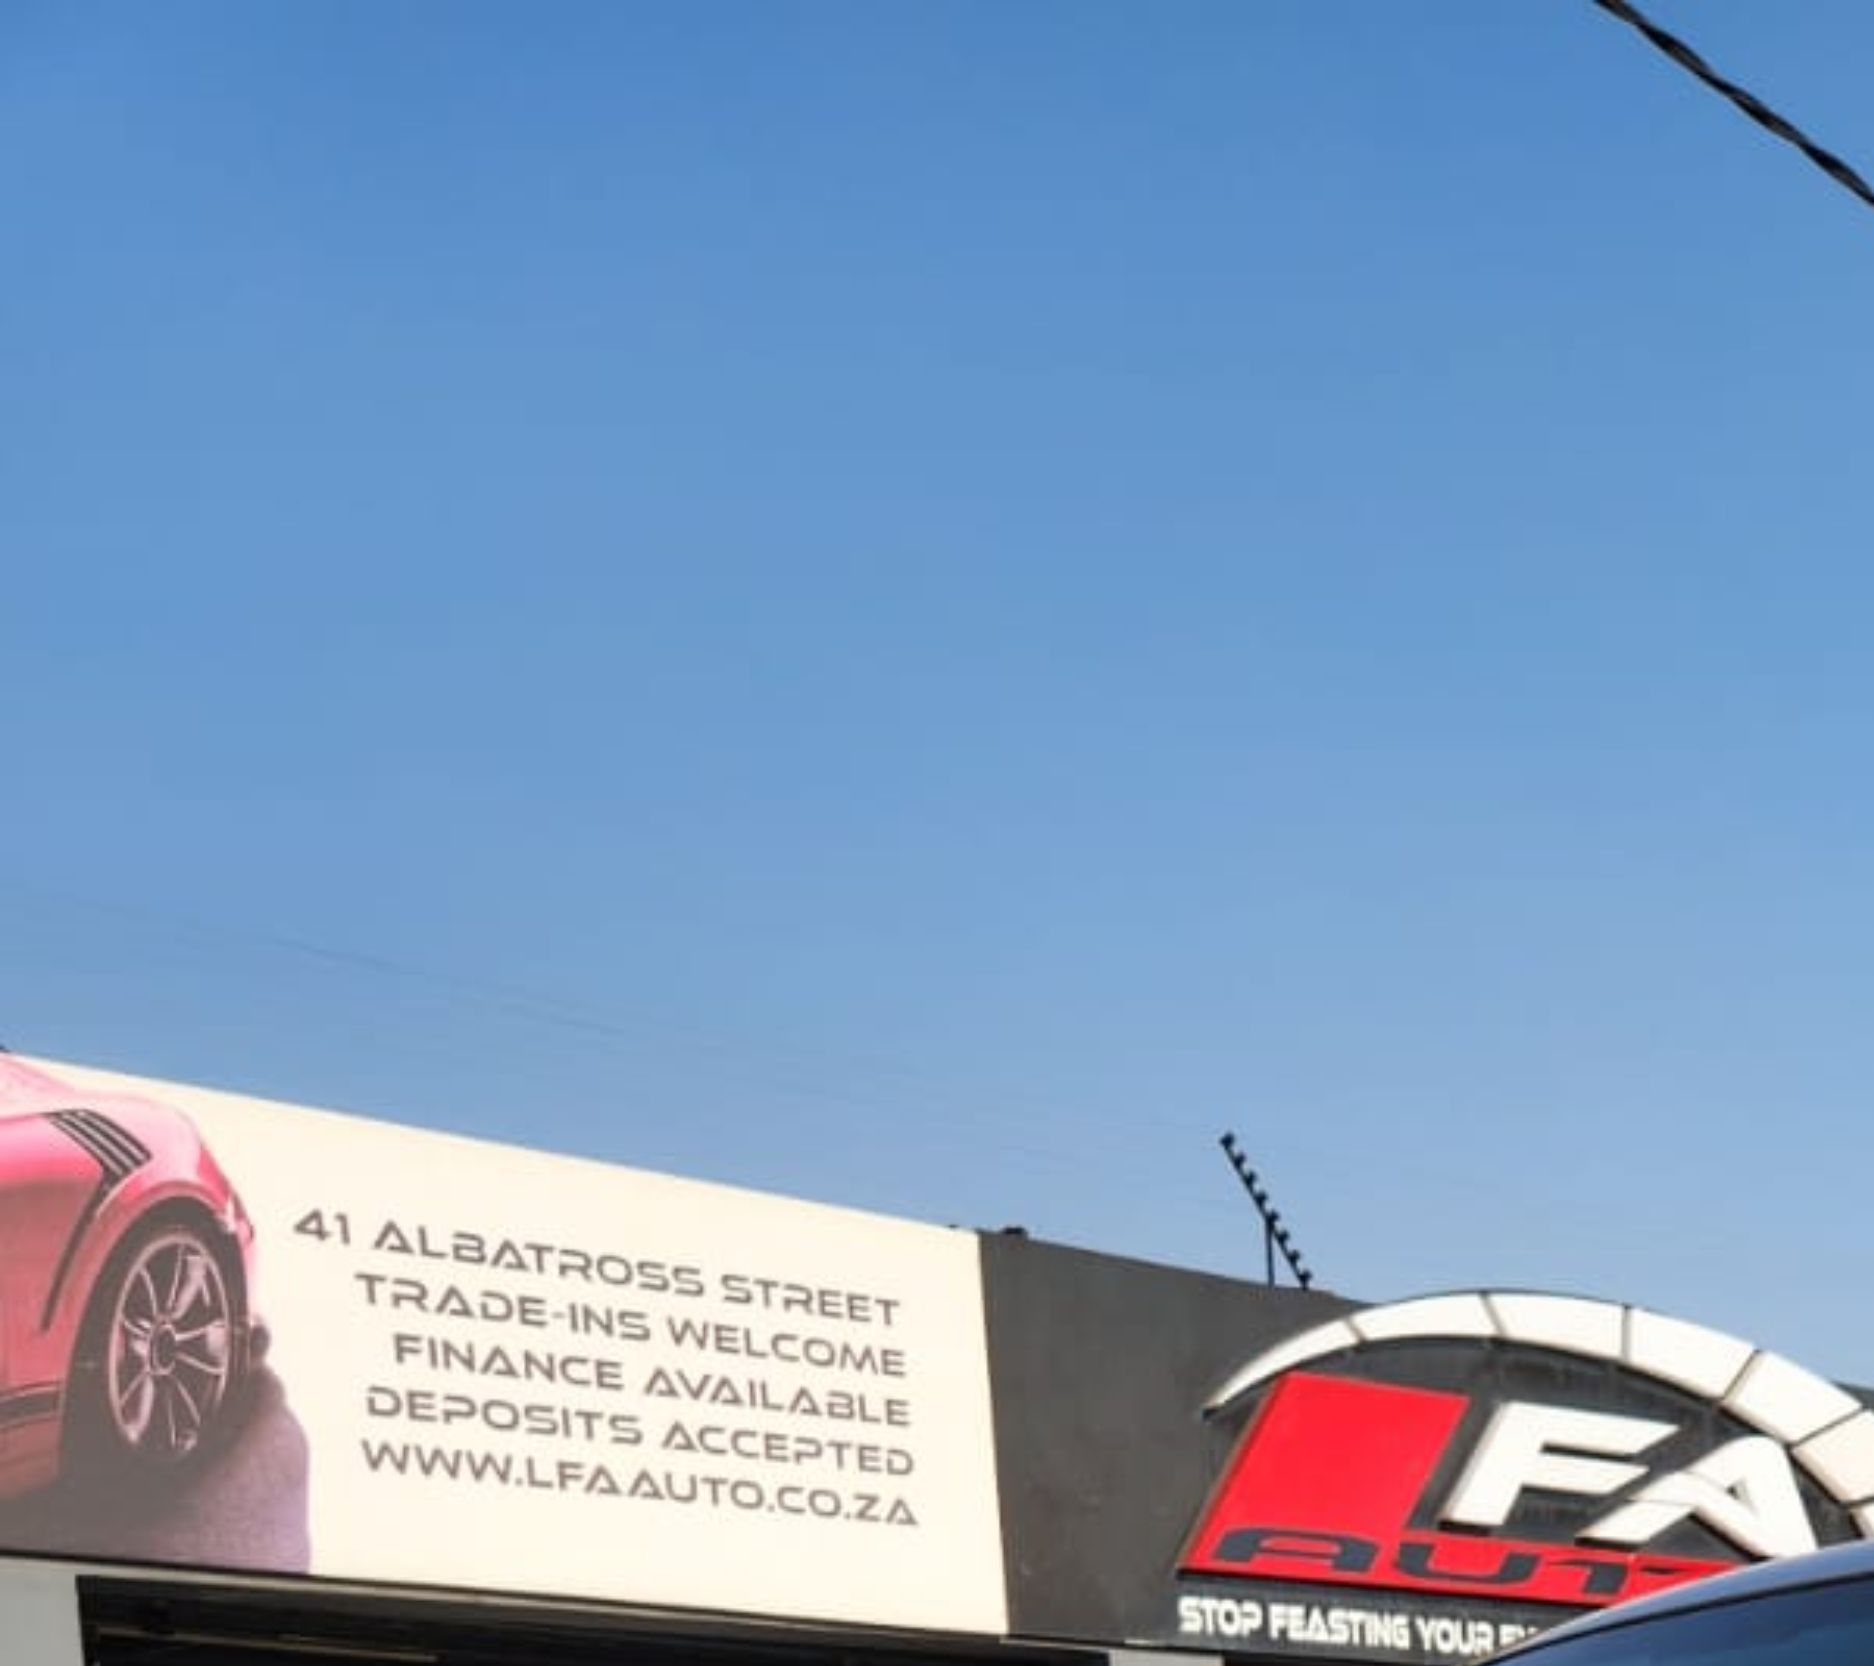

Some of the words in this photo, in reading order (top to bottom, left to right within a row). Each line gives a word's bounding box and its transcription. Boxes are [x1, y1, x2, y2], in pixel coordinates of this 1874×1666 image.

[294, 1208, 351, 1246] 41
[373, 1218, 704, 1298] ALBATROSS
[720, 1273, 901, 1327] STREET
[354, 1272, 650, 1342] TRADE-INS
[666, 1315, 907, 1378] WELCOME
[393, 1333, 625, 1391] FINANCE
[643, 1366, 912, 1428] AVAILABLE
[366, 1384, 644, 1446] DEPOSITS
[661, 1420, 914, 1476] ACCEPTED
[361, 1438, 919, 1527] WWW.LFAAUTO.CO.ZA
[1178, 1595, 1263, 1637] STOP
[1268, 1603, 1410, 1651] FEASTING
[1414, 1614, 1494, 1657] YOUR
